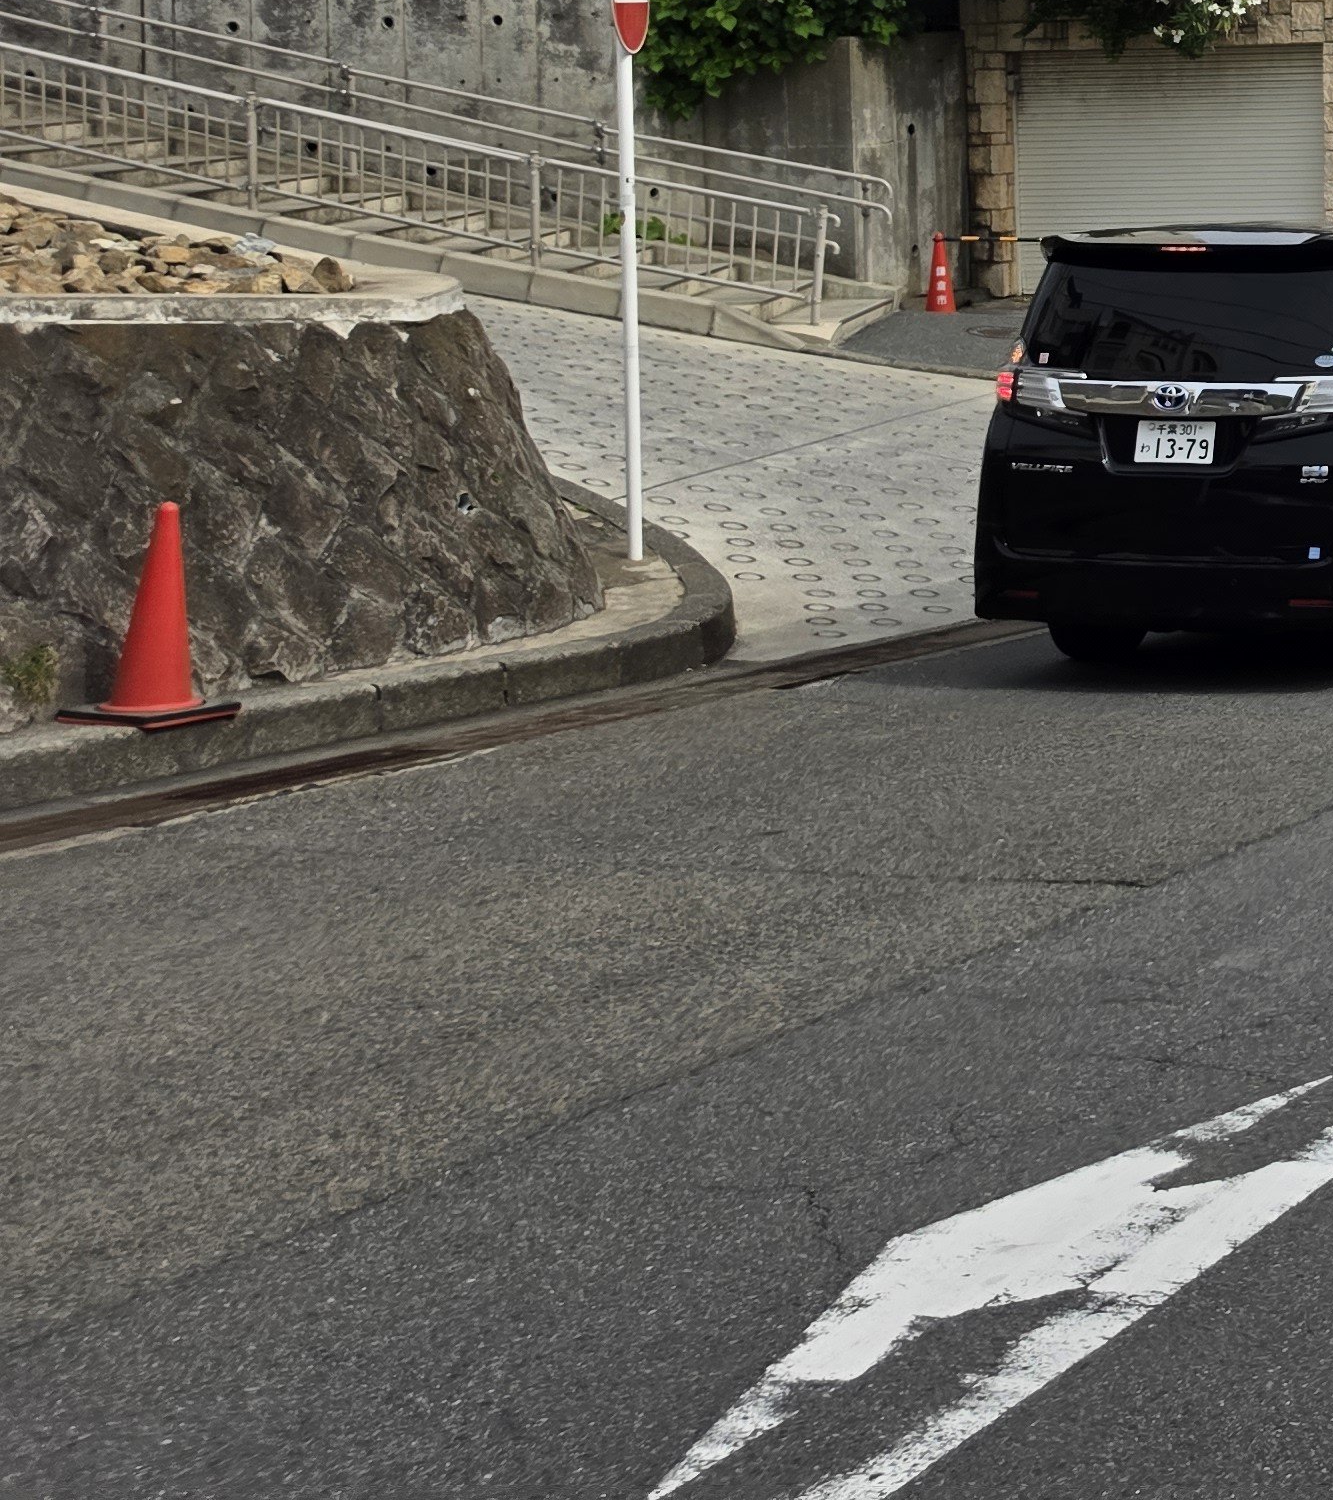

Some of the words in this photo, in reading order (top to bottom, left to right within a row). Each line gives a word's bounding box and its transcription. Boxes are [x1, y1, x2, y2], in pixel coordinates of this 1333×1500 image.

[1179, 424, 1198, 436] 301
[1140, 443, 1151, 453] わ
[1155, 438, 1209, 460] 13-79
